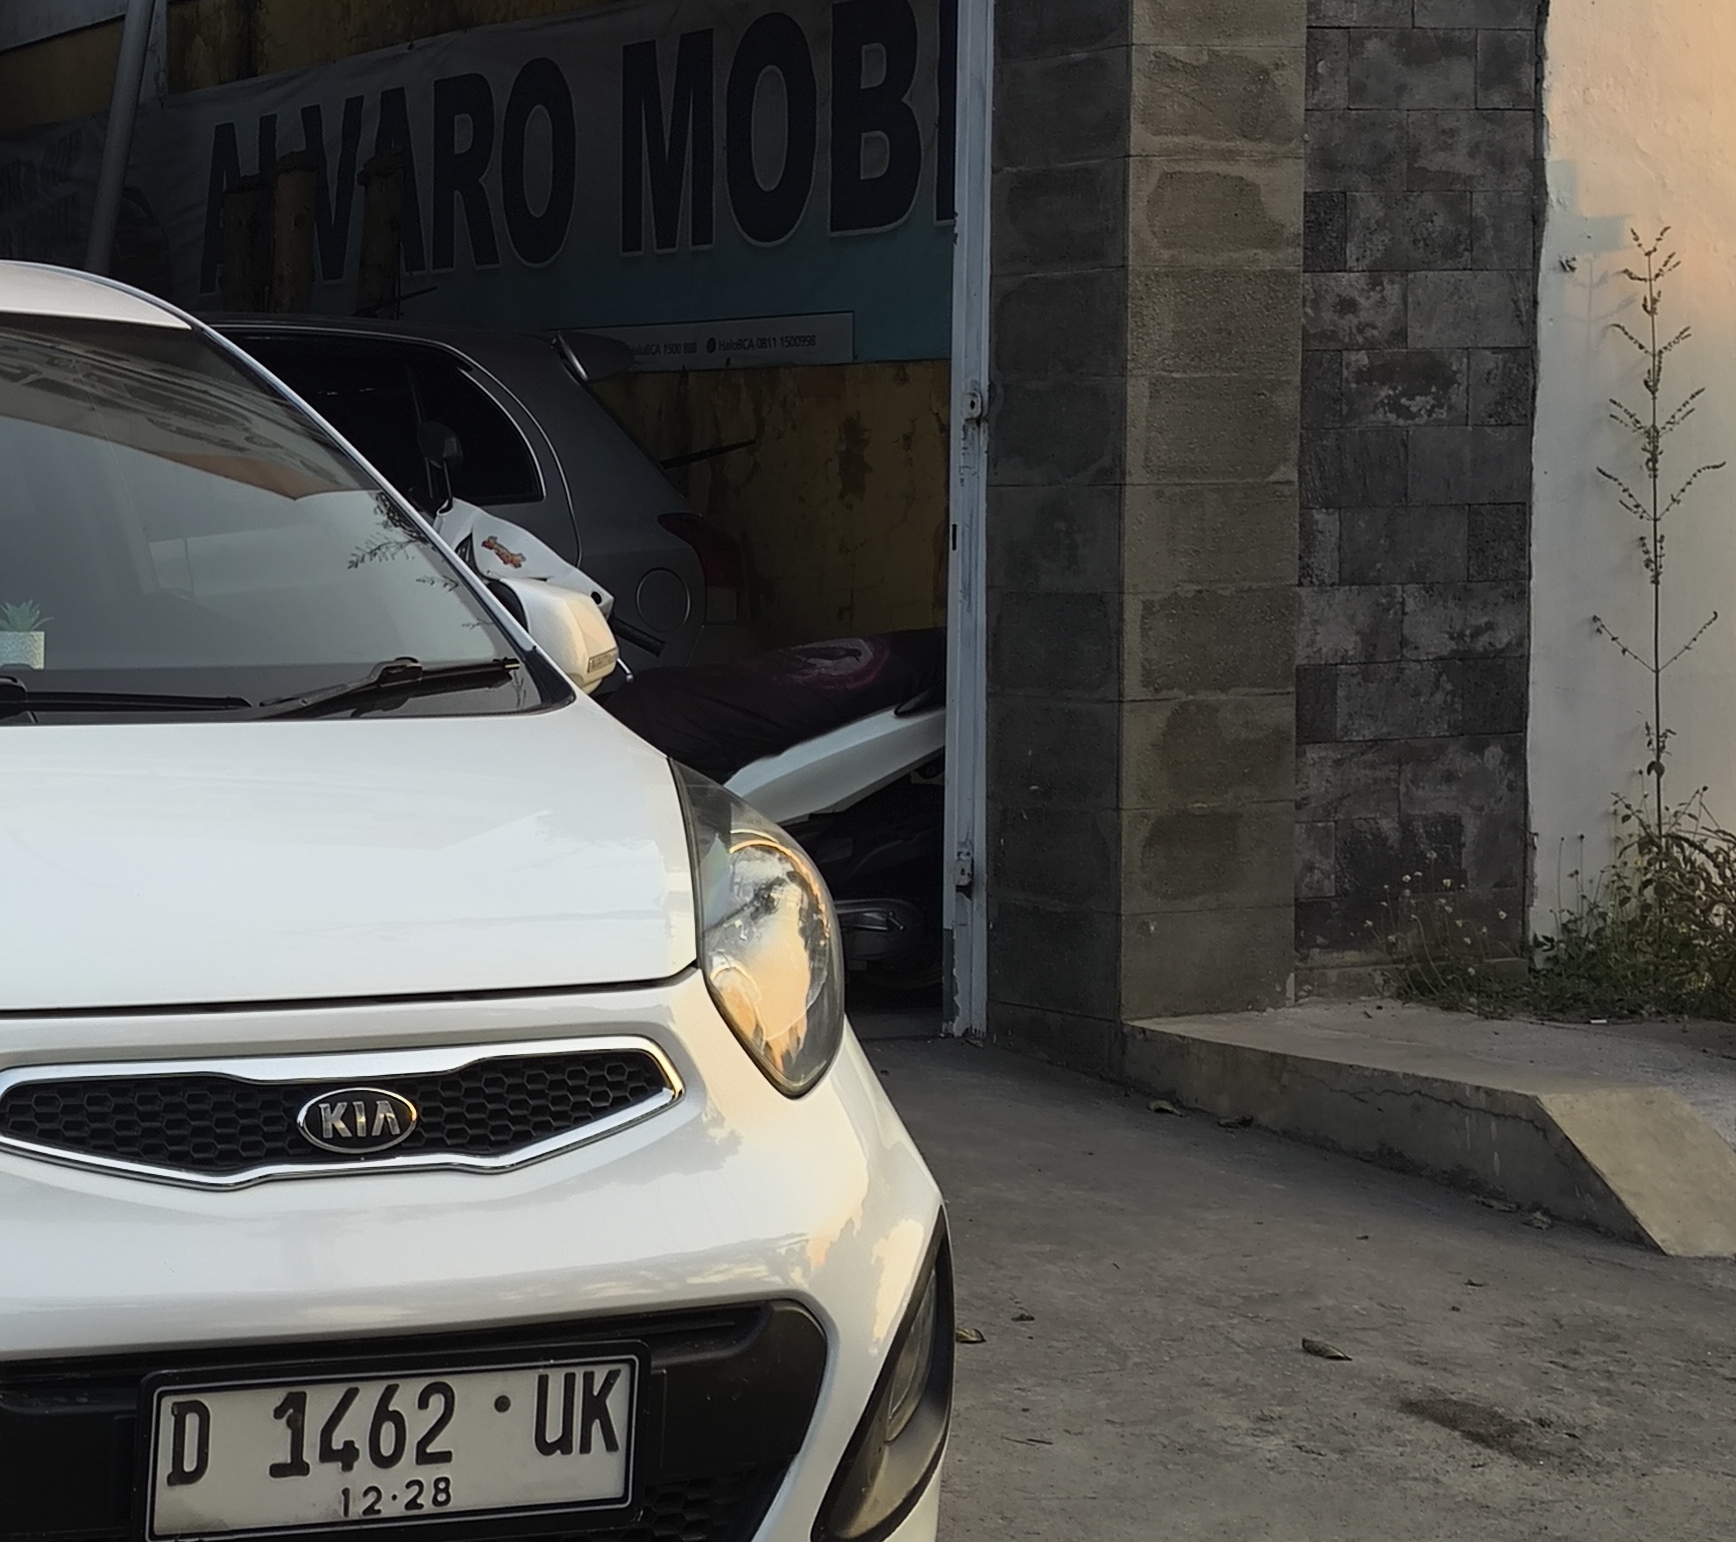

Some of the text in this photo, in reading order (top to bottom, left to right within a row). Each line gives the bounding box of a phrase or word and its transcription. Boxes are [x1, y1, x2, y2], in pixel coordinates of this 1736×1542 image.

[664, 342, 682, 355] 1500
[718, 338, 755, 352] HaloBCA
[756, 336, 777, 350] 0811
[780, 334, 816, 349] 1500998
[320, 1099, 402, 1139] KIA
[166, 1368, 622, 1487] D 1462 UK
